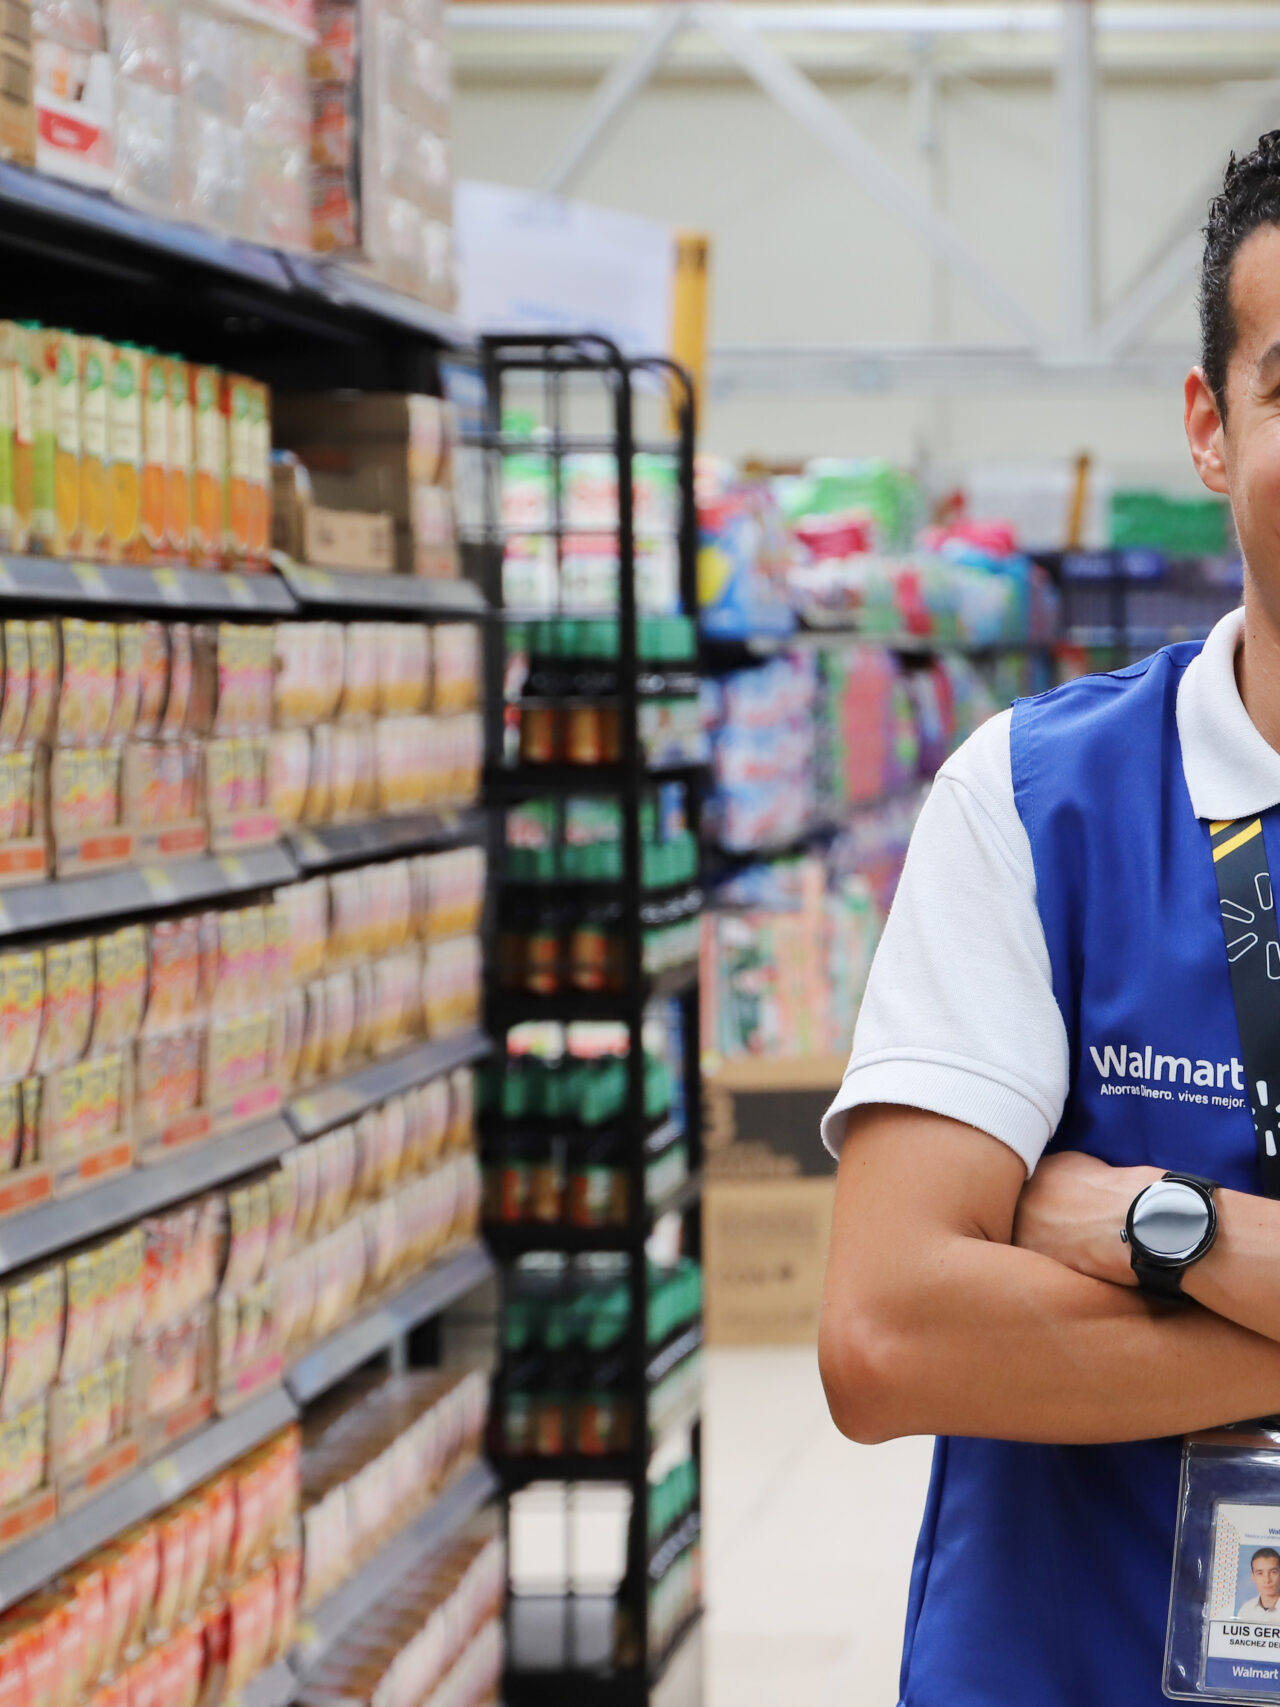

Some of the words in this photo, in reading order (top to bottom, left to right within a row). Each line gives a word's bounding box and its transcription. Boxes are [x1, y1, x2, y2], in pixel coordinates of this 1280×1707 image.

[1089, 1044, 1245, 1091] Walmart
[1100, 1083, 1140, 1096] Ahorras
[1178, 1090, 1209, 1105] vives
[1211, 1095, 1246, 1110] mejor.
[1223, 1625, 1250, 1637] LUIS
[1229, 1638, 1266, 1648] SANCHEZ
[1232, 1665, 1279, 1680] Walmart
